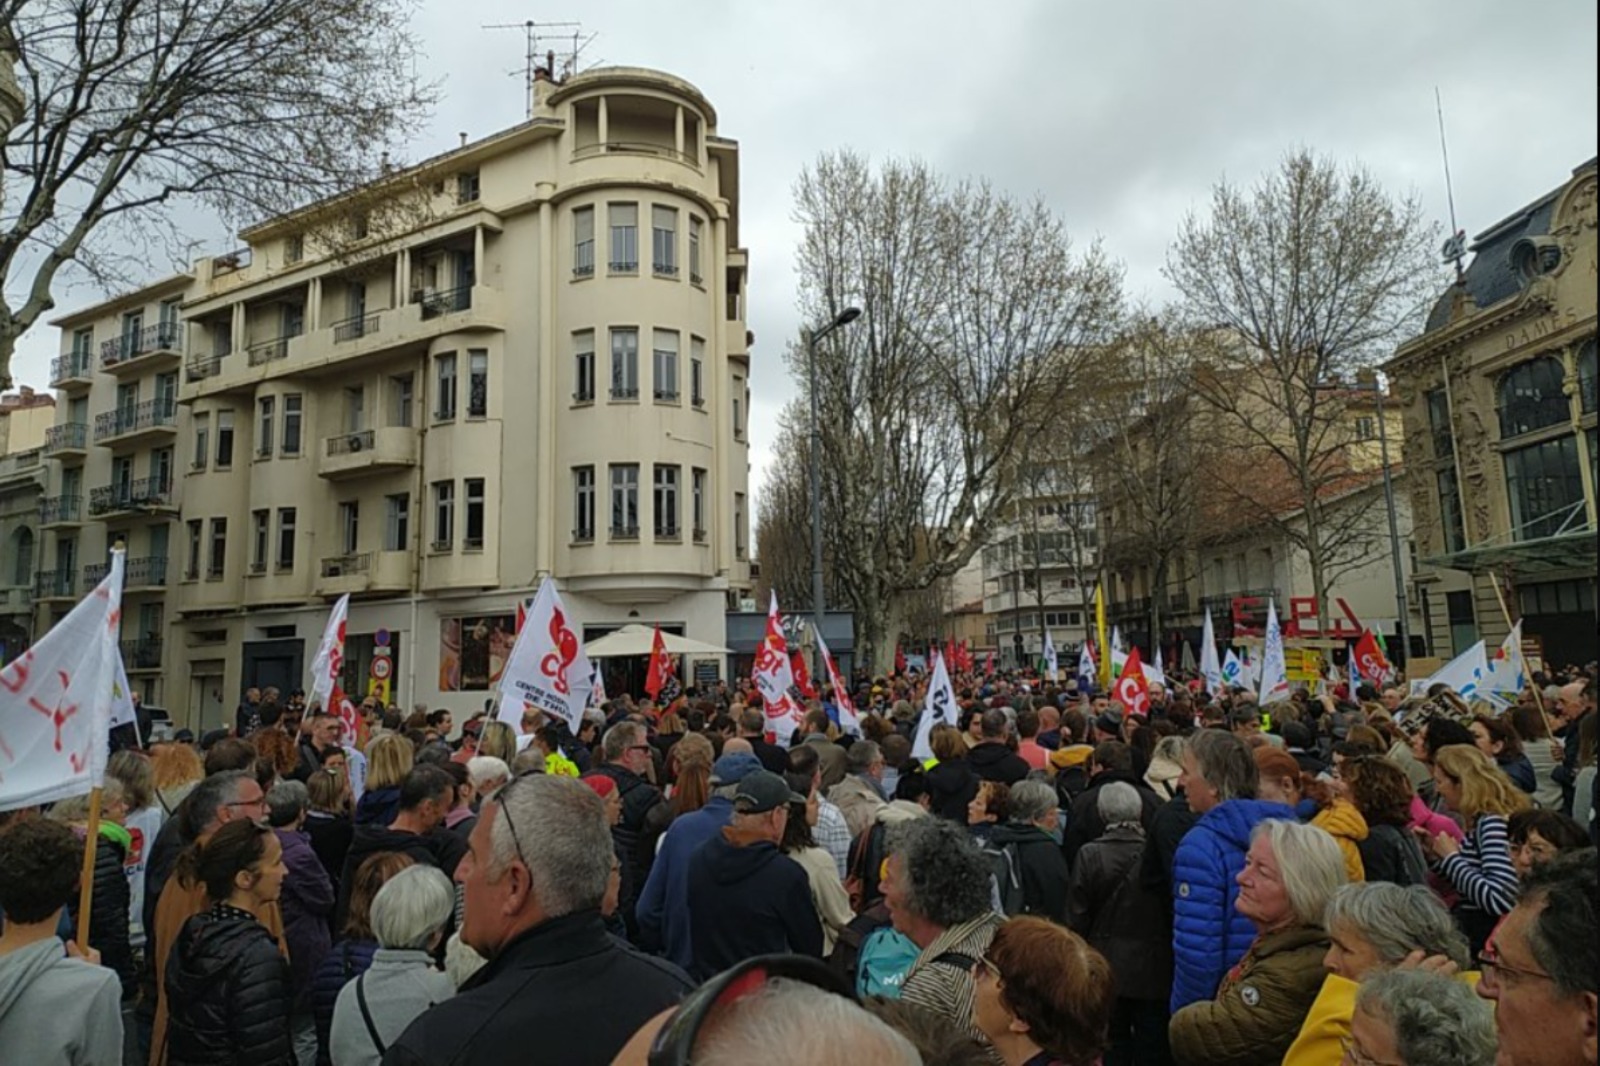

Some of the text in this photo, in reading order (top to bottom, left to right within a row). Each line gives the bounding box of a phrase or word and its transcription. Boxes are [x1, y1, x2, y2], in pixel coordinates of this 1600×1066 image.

[1505, 307, 1578, 350] DAMES
[515, 680, 545, 697] CENTRE
[541, 653, 571, 695] cg
[524, 692, 540, 704] DE
